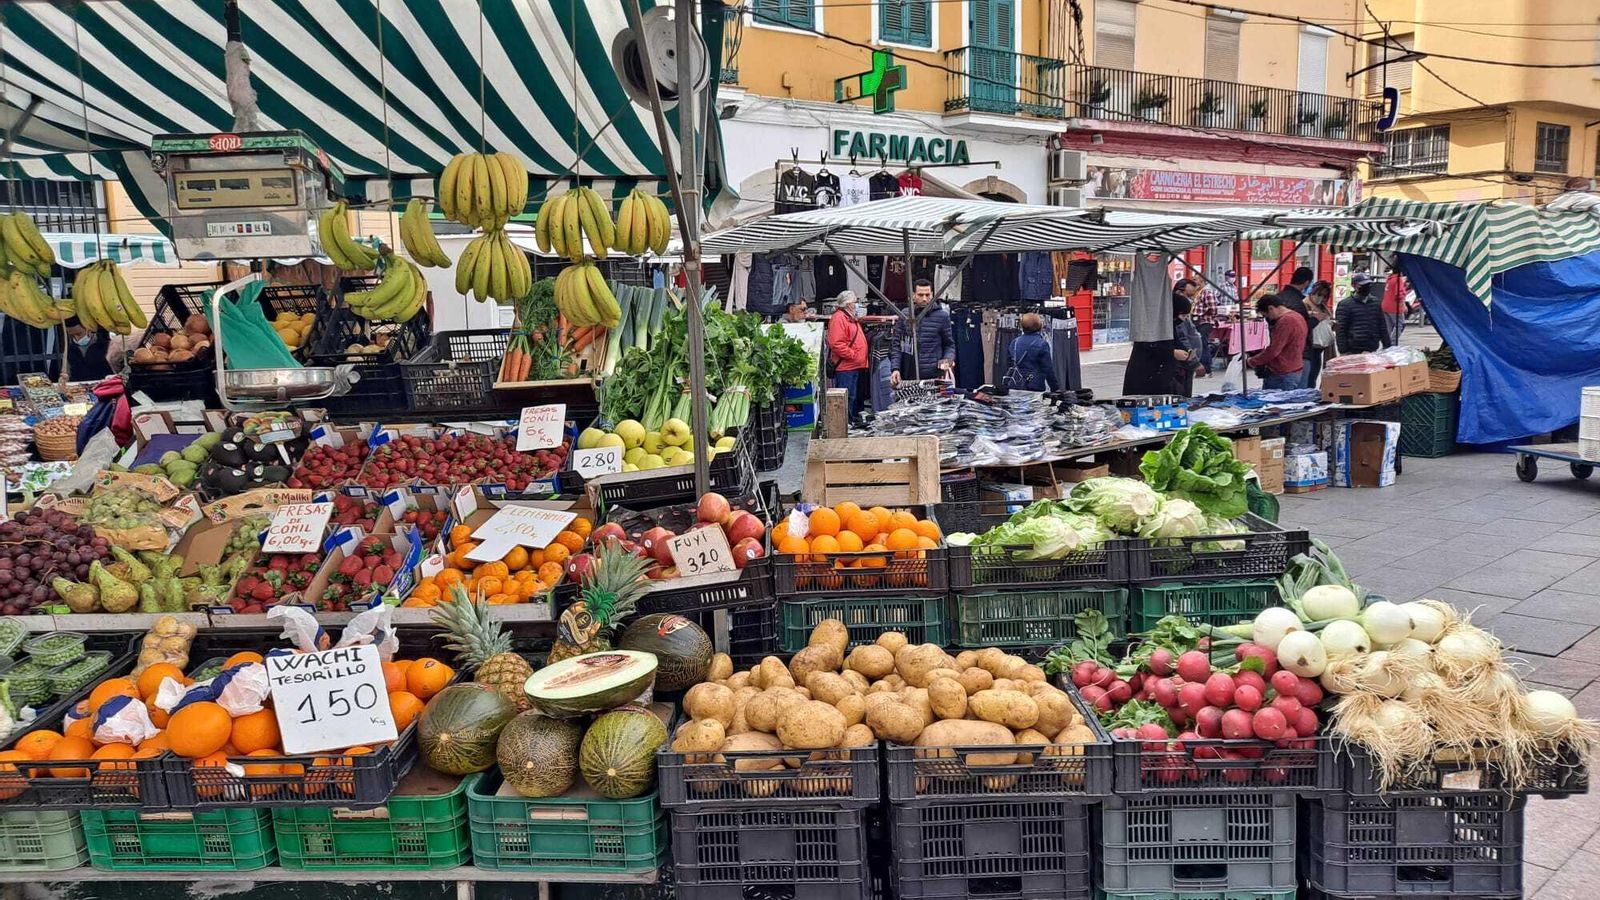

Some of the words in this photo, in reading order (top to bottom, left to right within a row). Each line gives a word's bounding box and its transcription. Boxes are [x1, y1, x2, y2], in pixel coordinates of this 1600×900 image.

[210, 136, 242, 151] TROPS
[834, 129, 970, 164] FARMACIA
[1194, 174, 1202, 188] EL
[1203, 175, 1237, 190] ESTRECHO
[524, 407, 558, 415] FRESAS
[276, 504, 328, 517] FRESAS
[269, 524, 312, 535] CONIL
[272, 647, 364, 672] WACHI
